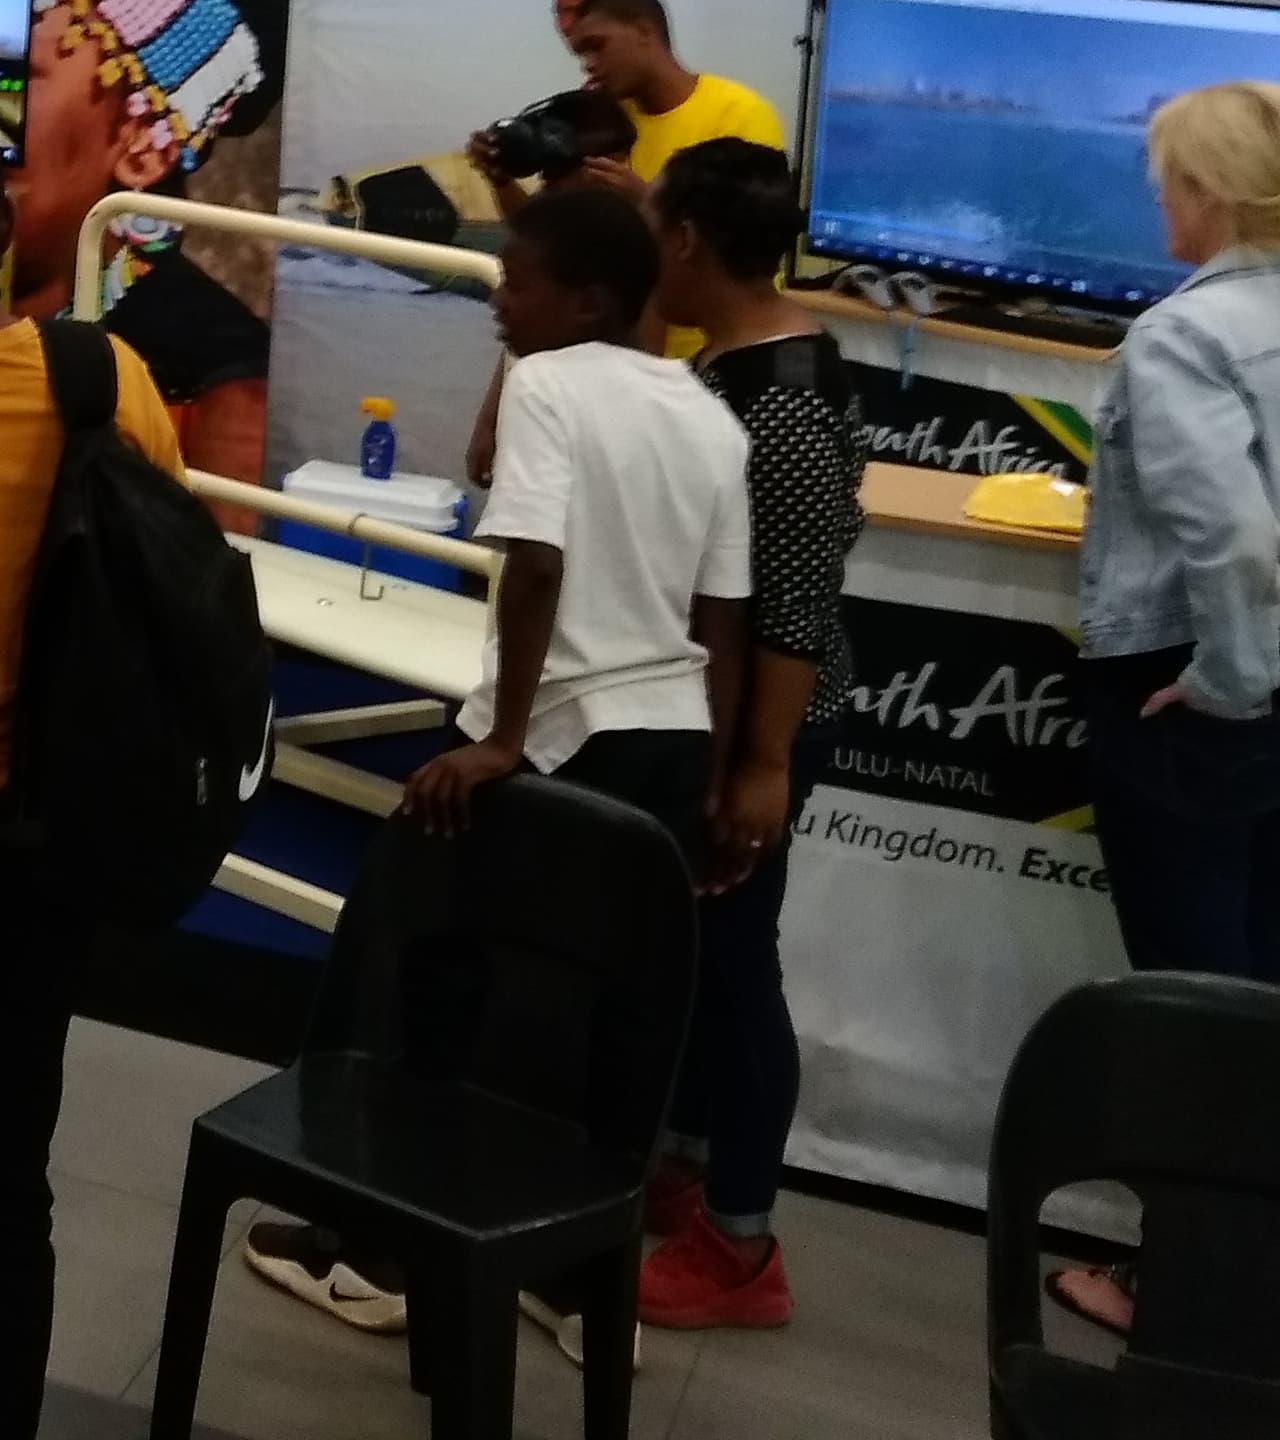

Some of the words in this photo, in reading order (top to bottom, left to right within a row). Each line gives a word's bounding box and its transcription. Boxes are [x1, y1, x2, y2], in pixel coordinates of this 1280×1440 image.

[850, 417, 942, 463] outh
[831, 745, 995, 797] ULU-NATAL
[824, 808, 1005, 874] Kingdom.
[1019, 846, 1110, 894] Exce
